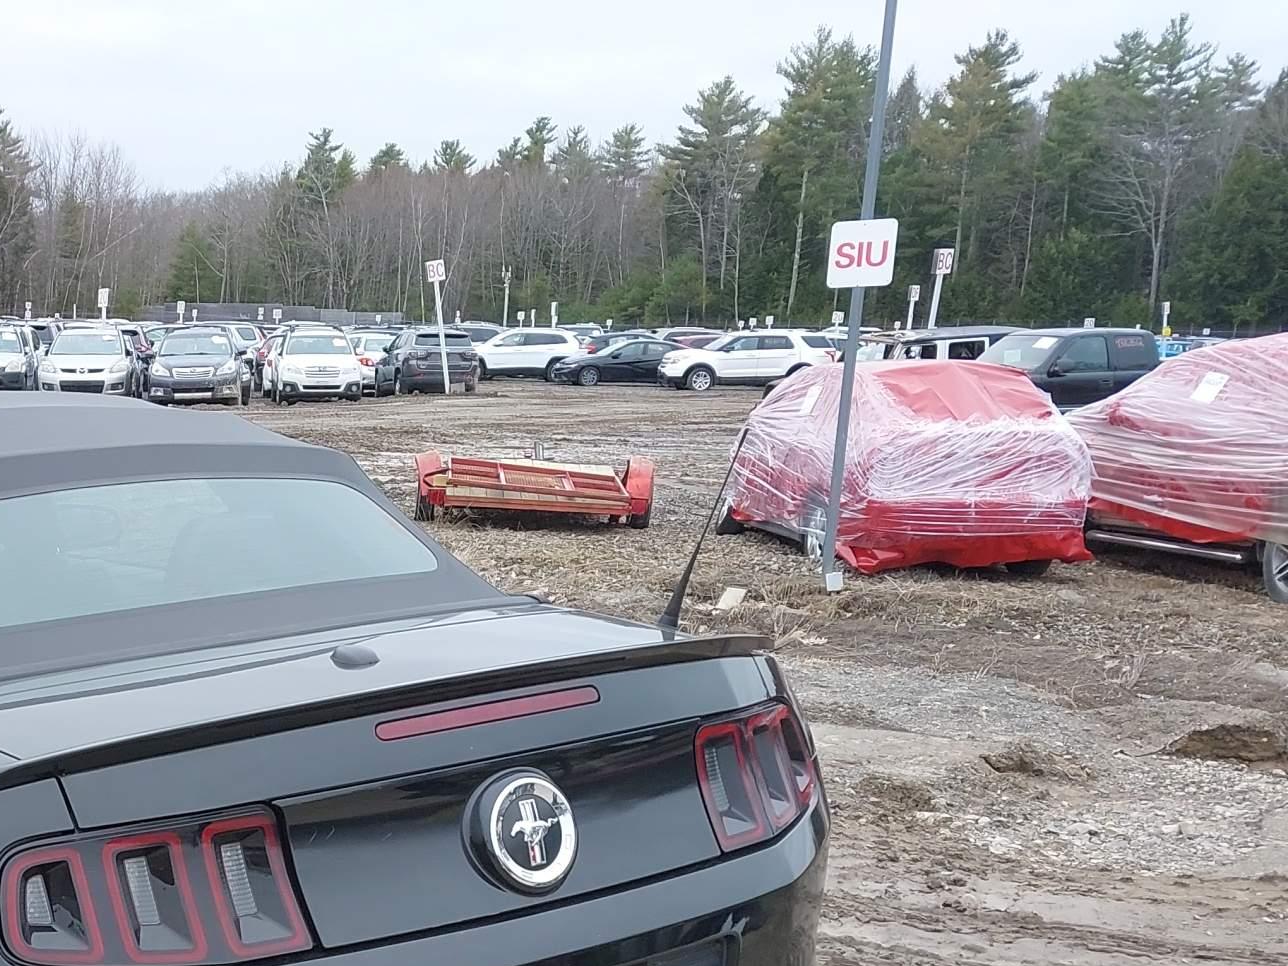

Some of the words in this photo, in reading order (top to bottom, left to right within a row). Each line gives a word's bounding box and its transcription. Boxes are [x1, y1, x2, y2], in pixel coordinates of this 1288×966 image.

[835, 240, 889, 269] SIU
[937, 252, 953, 270] BC
[428, 263, 443, 278] BC
